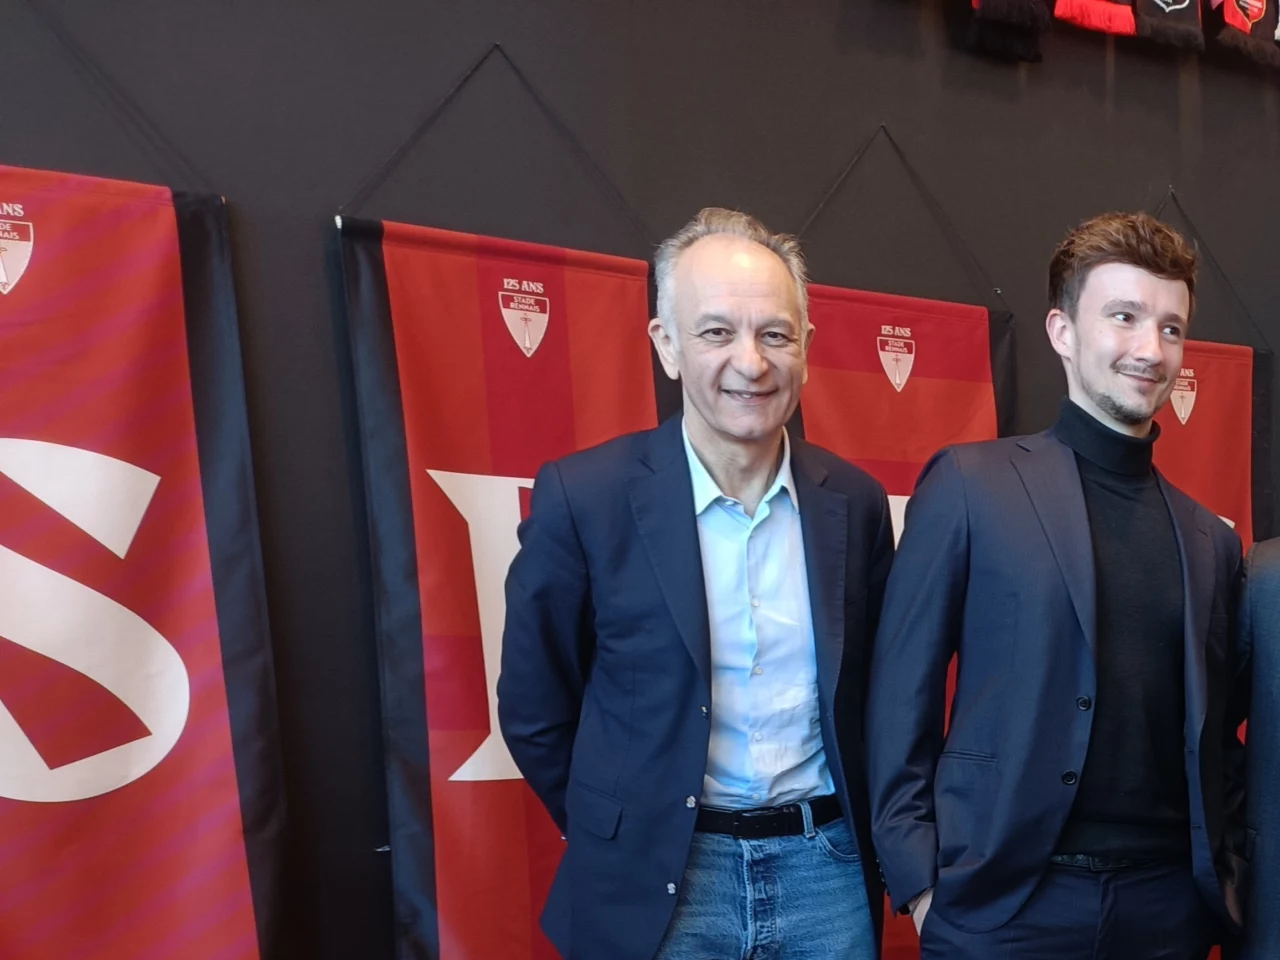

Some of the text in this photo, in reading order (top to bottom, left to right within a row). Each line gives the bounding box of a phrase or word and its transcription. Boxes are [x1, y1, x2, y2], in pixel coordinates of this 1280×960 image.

[503, 277, 544, 293] 125 ANS
[513, 295, 536, 305] STADE
[509, 302, 540, 313] RENNAIS
[894, 326, 911, 337] ANS
